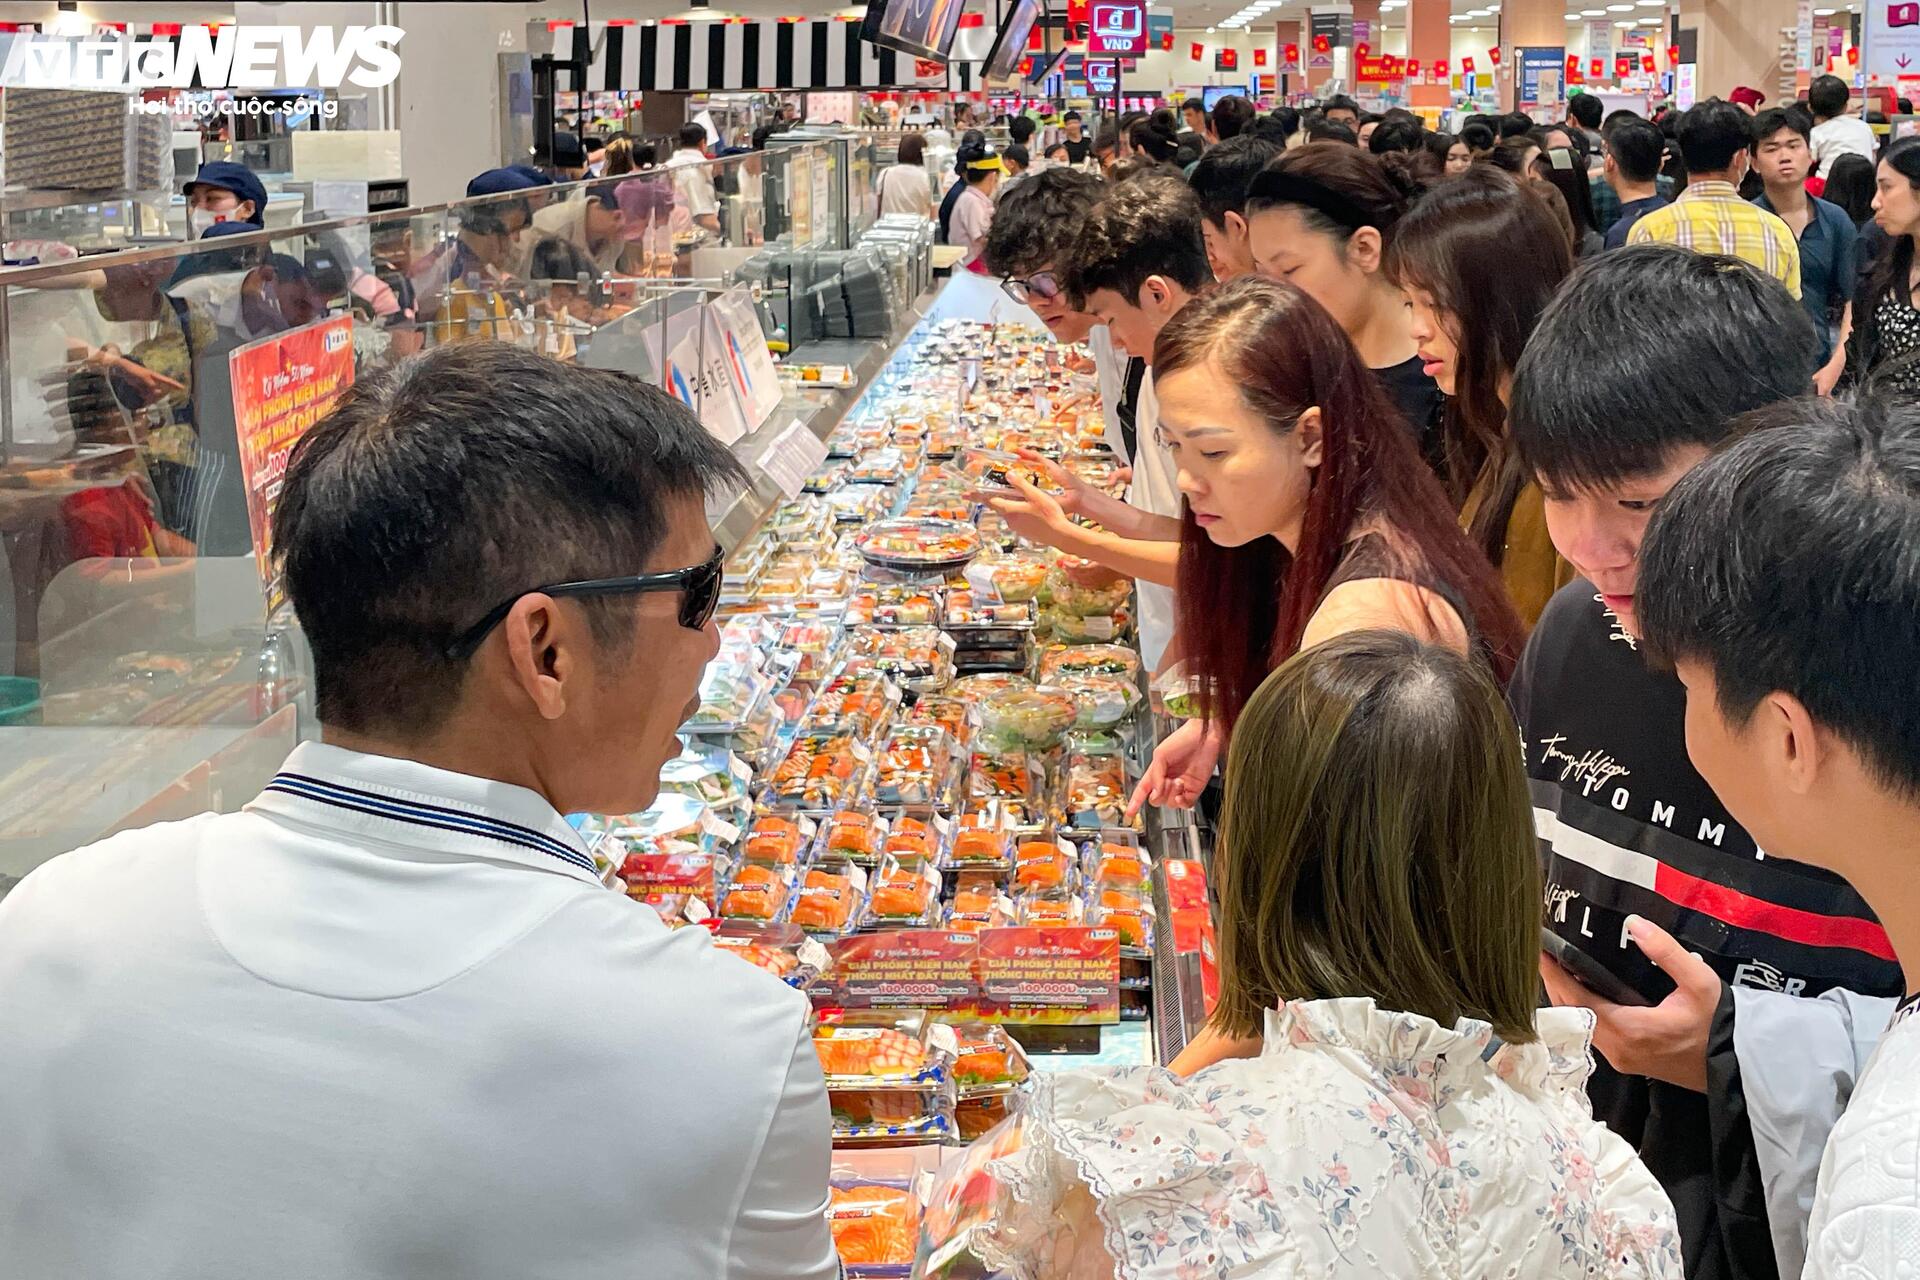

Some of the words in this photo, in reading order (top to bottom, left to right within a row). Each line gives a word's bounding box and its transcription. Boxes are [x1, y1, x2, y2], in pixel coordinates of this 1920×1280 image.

[1102, 38, 1133, 50] VND
[678, 885, 706, 894] NAM
[943, 960, 971, 970] NAM
[1013, 958, 1052, 969] PHÓNG
[1083, 958, 1111, 969] NAM
[884, 969, 915, 980] NHẤT
[941, 969, 973, 980] NƯỚC
[1024, 968, 1055, 980] NHẤT
[1081, 968, 1113, 980] NƯỚC
